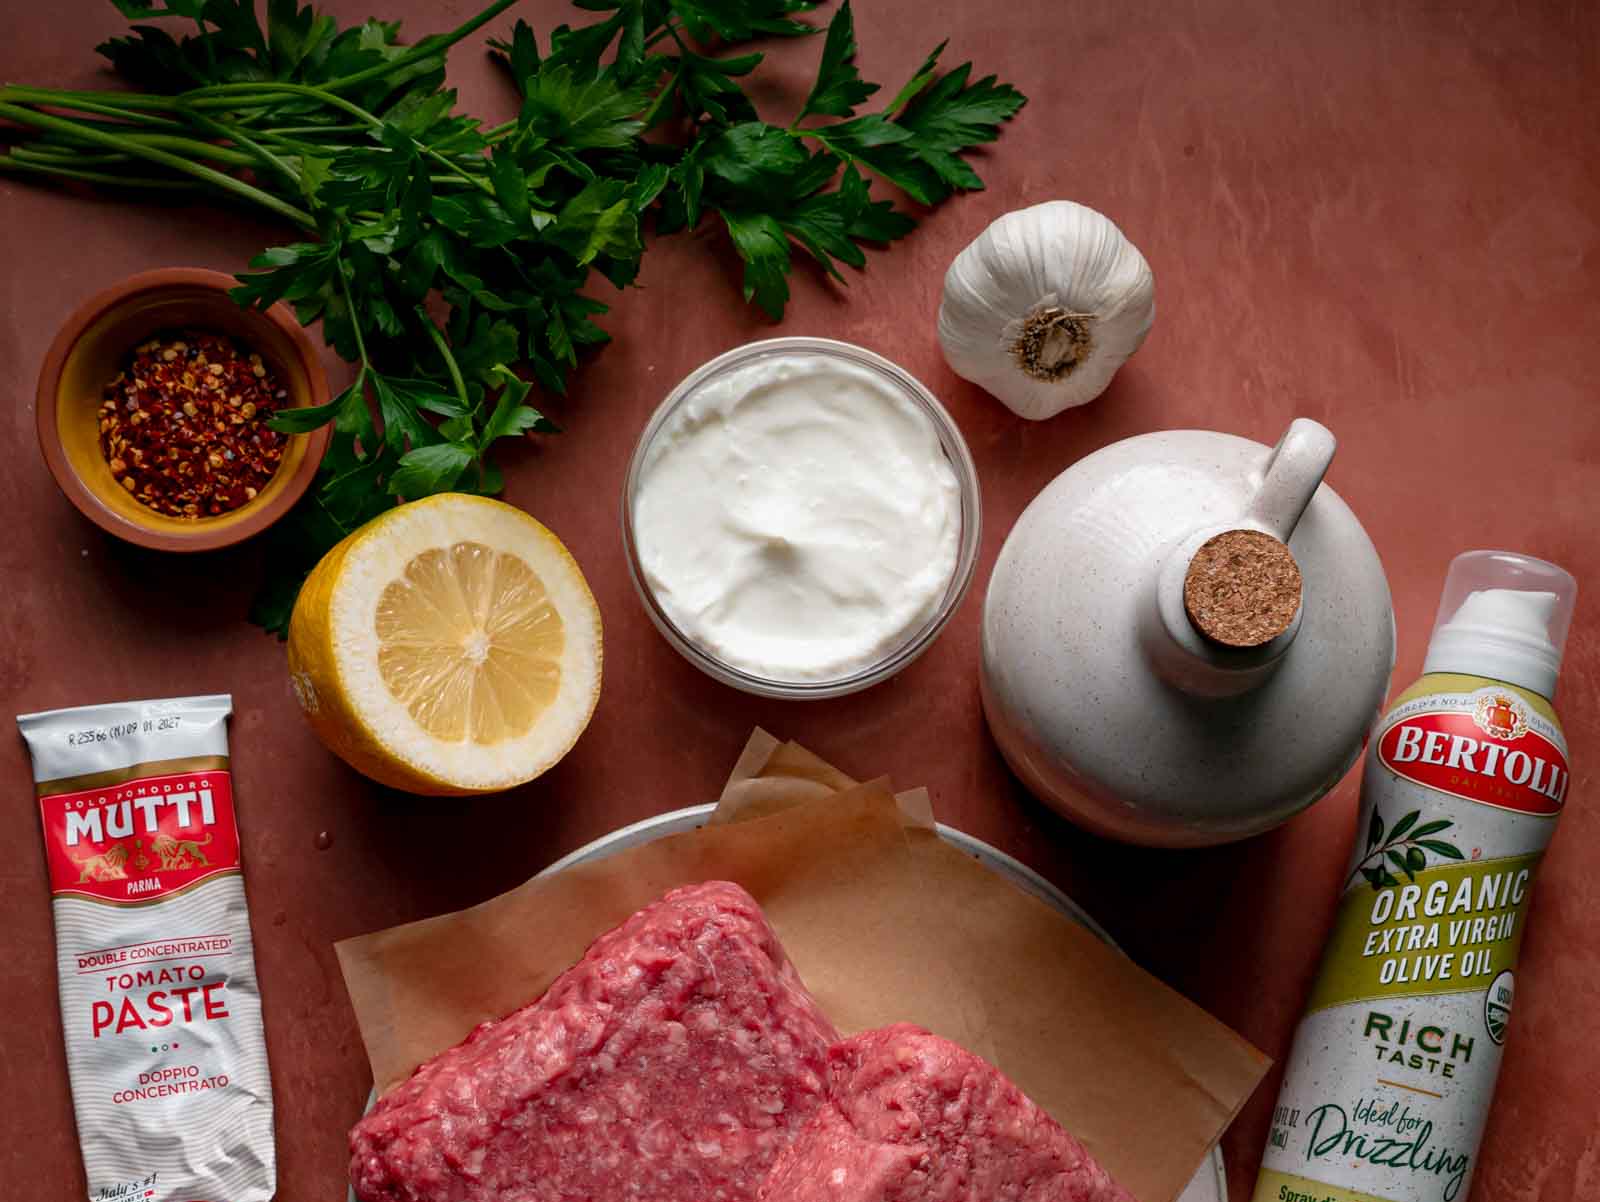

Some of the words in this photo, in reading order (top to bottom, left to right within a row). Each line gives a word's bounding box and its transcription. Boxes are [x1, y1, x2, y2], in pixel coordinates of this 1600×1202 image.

[1393, 726, 1569, 803] BERTOLLI
[65, 798, 107, 810] SOLO
[65, 789, 216, 846] MUTTI
[127, 877, 161, 895] PARMA
[1370, 869, 1529, 925] ORGANIC
[1362, 923, 1440, 957] EXTRA
[1449, 912, 1516, 946] VIRGIN
[78, 952, 128, 969] DOUBLE
[1379, 953, 1455, 985] OLIVE
[1460, 949, 1493, 977] OIL
[106, 965, 206, 992] TOMATO
[92, 981, 230, 1039] PASTE
[1363, 1011, 1476, 1064] RICH
[138, 1065, 200, 1086] DOPPIO
[1375, 1045, 1456, 1078] TASTE
[112, 1075, 230, 1104] CONCENTRATO
[1352, 1098, 1399, 1127] Ideal
[1396, 1105, 1423, 1133] for
[1305, 1103, 1469, 1202] Drizzling
[96, 1181, 139, 1202] Italy's
